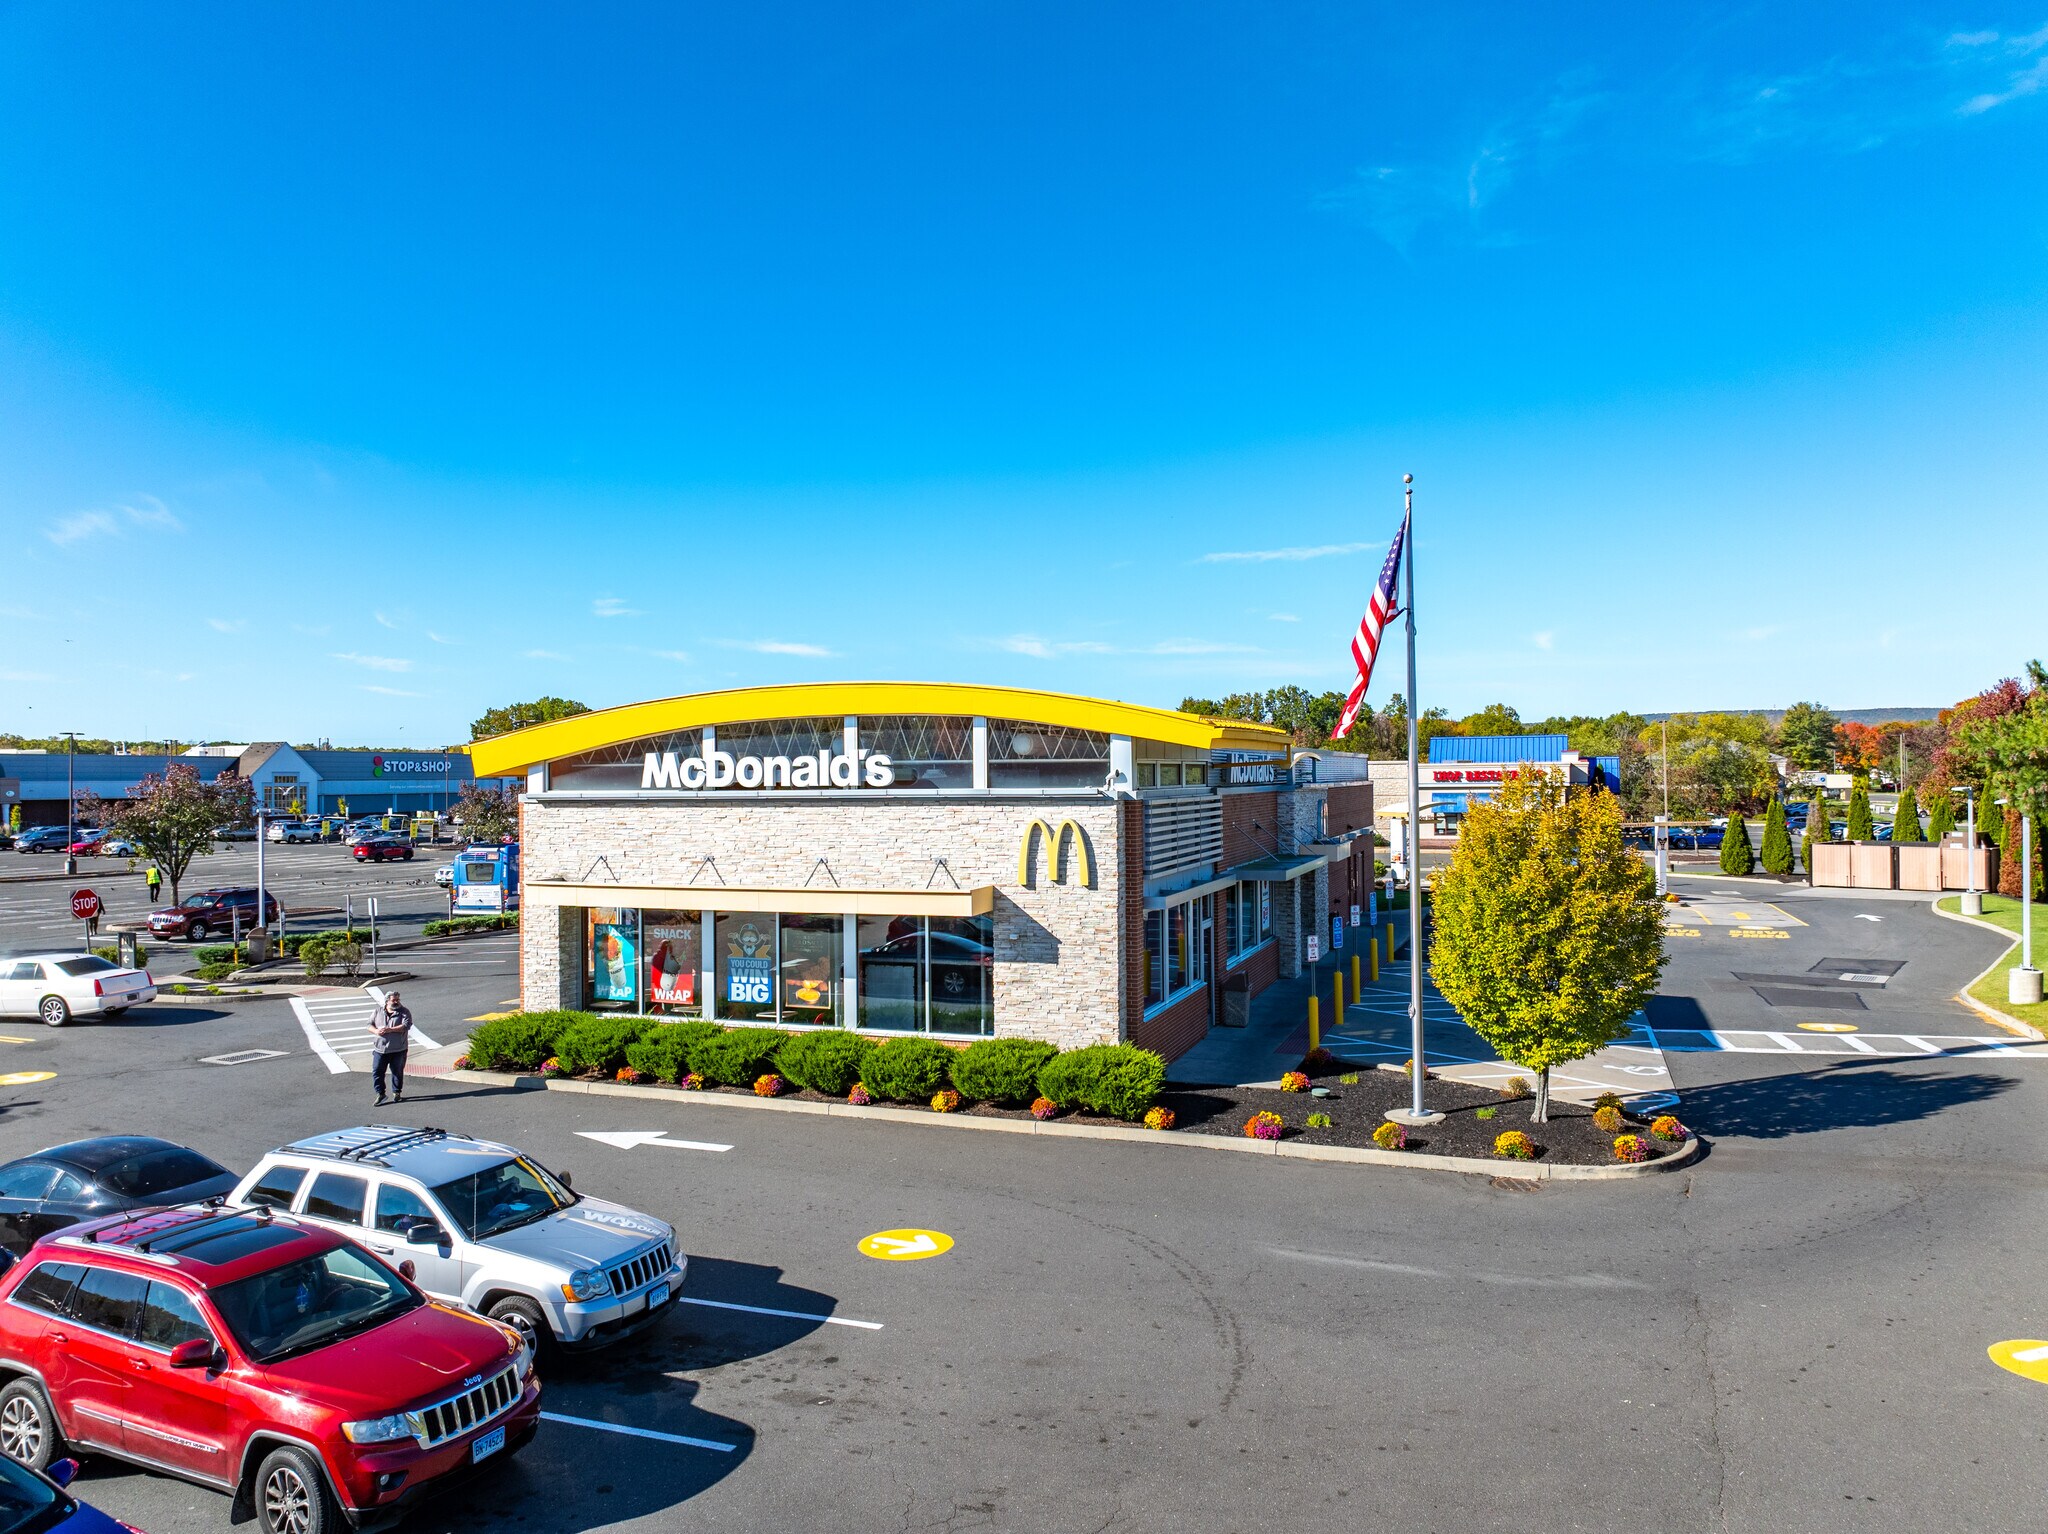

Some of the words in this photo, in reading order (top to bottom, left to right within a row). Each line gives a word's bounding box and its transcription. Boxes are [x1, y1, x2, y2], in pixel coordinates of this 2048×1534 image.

[383, 760, 452, 773] STOP&SHOP
[641, 749, 896, 788] McDonald's
[1433, 770, 1464, 782] IHOP
[73, 897, 97, 911] STOP
[596, 926, 633, 938] SNACK
[653, 928, 692, 940] SNACK
[730, 960, 745, 968] YOU
[746, 960, 768, 968] COULD
[730, 968, 769, 984] WIN
[597, 984, 632, 998] WRAP
[654, 988, 691, 1002] WRAP
[731, 982, 770, 1003] BIG
[464, 1374, 482, 1386] Jeep
